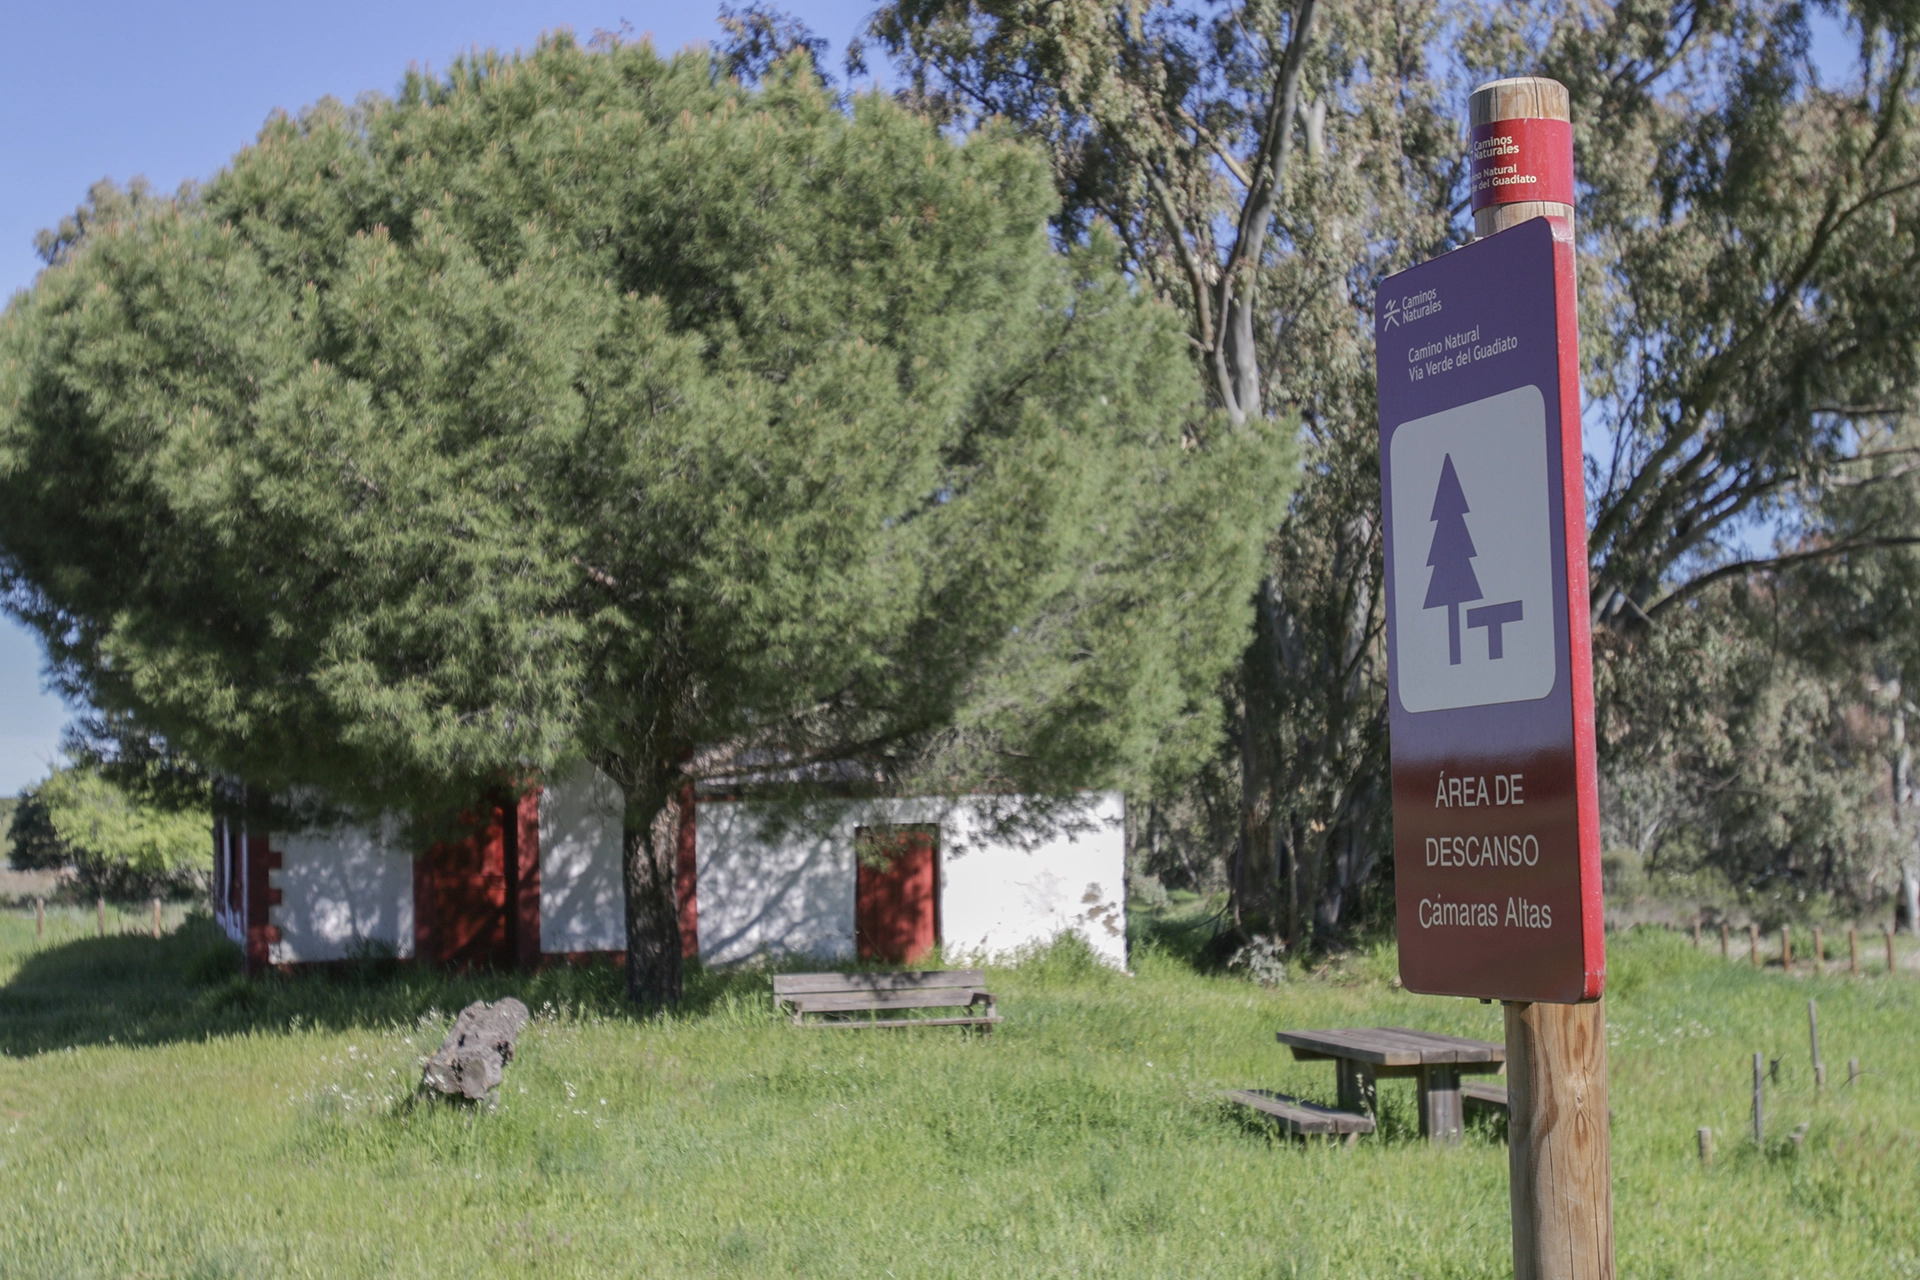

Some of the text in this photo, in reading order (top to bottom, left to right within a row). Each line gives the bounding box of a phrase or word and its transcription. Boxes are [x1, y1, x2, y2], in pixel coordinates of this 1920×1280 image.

[1474, 136, 1512, 151] Caminos
[1474, 144, 1520, 161] Naturales
[1478, 179, 1490, 190] del
[1492, 174, 1537, 186] Guadiato
[1483, 163, 1517, 177] Natural
[1402, 288, 1437, 310] Caminos
[1402, 300, 1442, 324] Naturales
[1408, 325, 1480, 363] Camino Natural
[1409, 336, 1518, 382] Vía Verde del Guadiato
[1435, 771, 1524, 808] ÁREA DE
[1426, 834, 1539, 867] DESCANSO
[1419, 893, 1552, 929] Cámaras Altas
